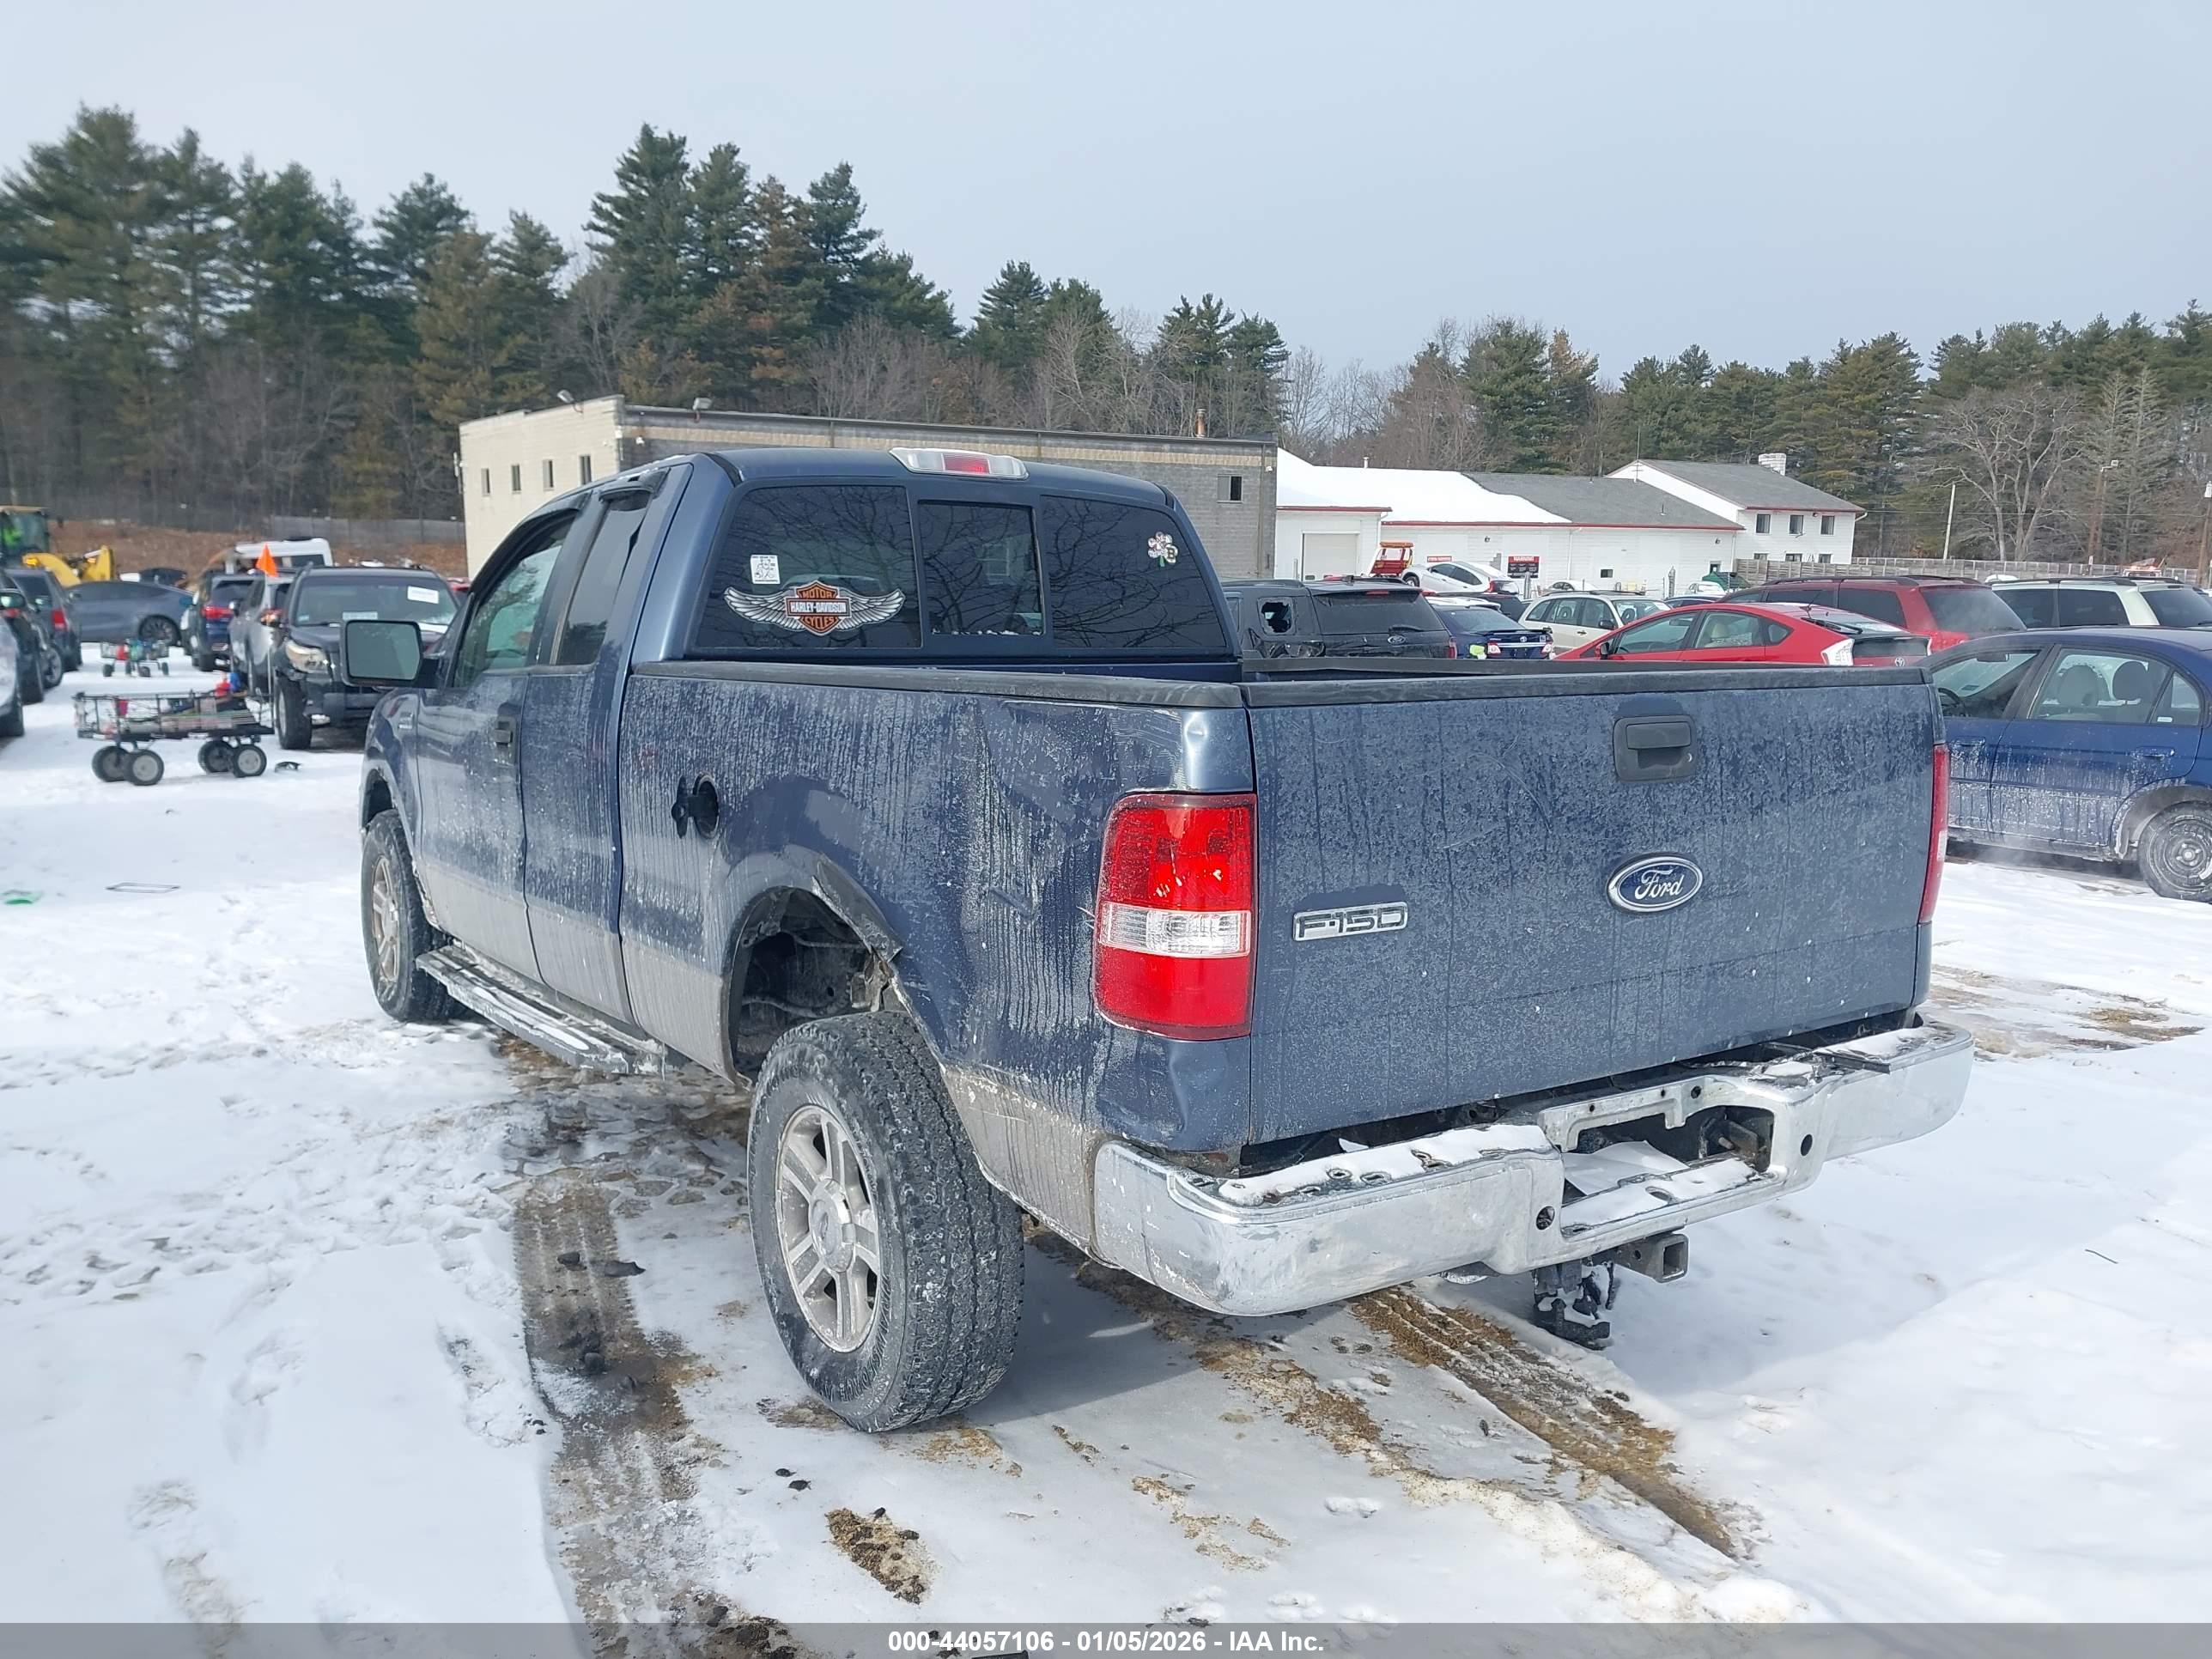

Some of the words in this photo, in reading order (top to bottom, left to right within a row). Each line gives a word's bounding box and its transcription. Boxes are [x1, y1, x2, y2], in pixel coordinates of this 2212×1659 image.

[802, 588, 833, 599] MOTOR
[790, 601, 847, 613] HARLEY-DAVIDSON
[804, 617, 835, 629] CYCLES
[1634, 868, 1684, 900] Ford
[1298, 905, 1405, 939] F-150
